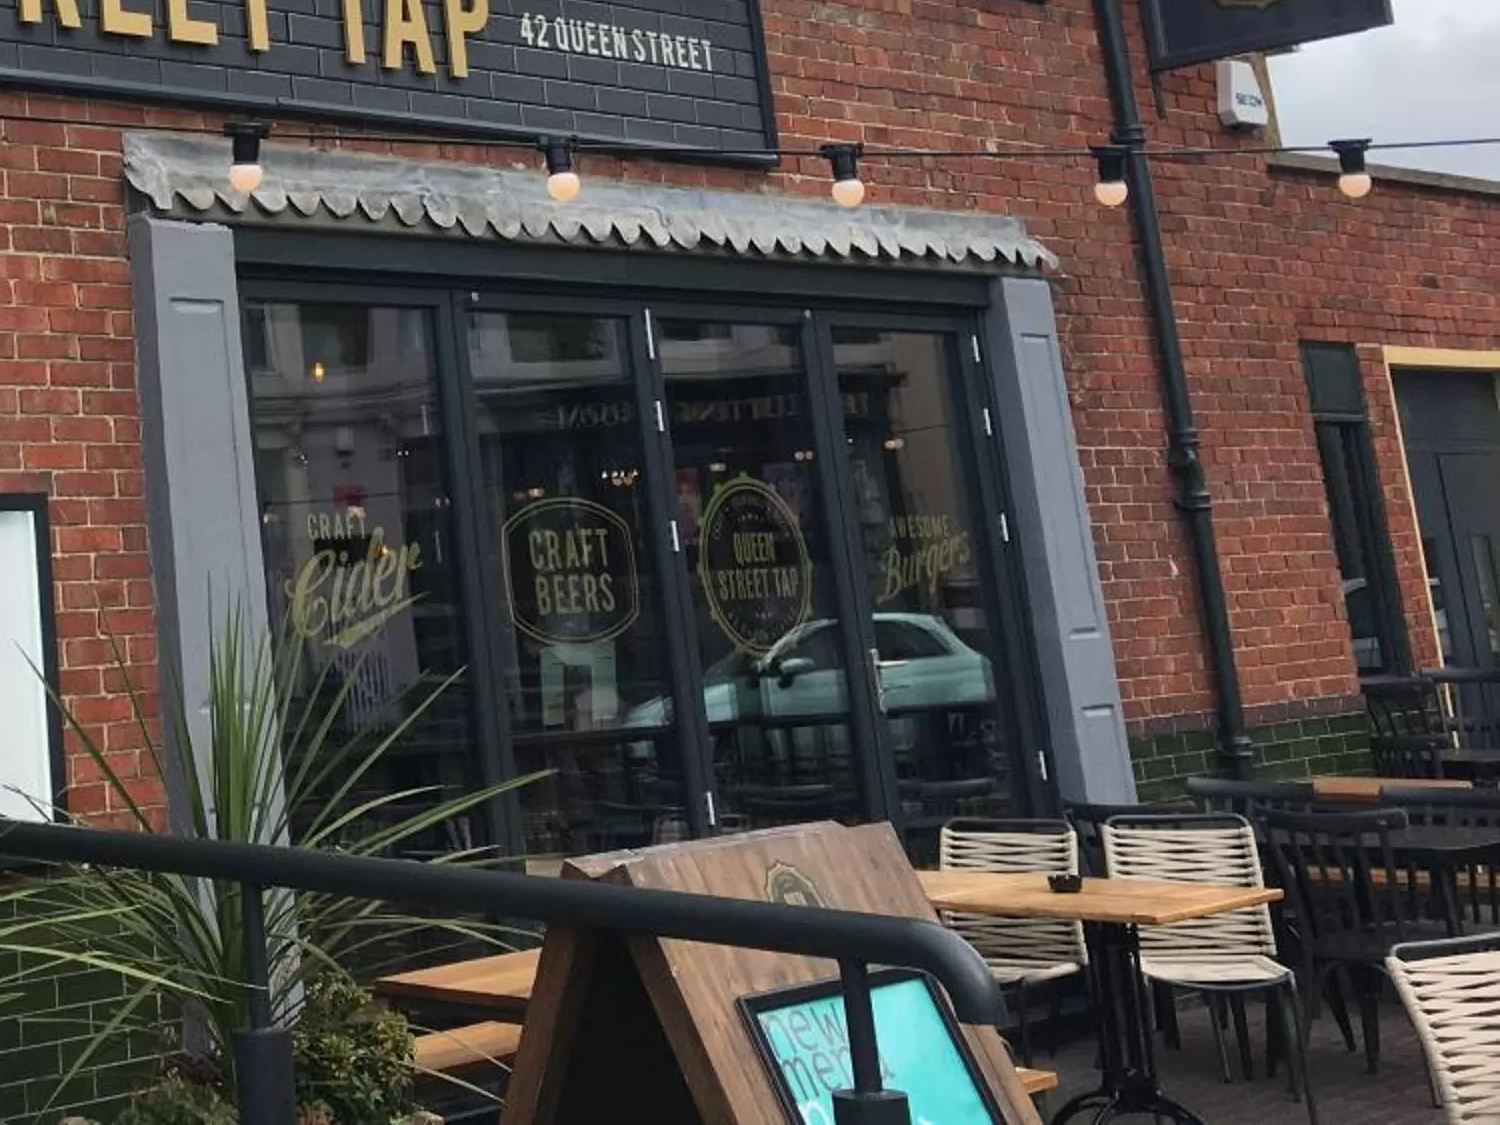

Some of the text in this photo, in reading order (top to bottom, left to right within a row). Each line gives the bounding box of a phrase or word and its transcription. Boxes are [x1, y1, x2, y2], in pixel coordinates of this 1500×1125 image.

[519, 12, 714, 72] 42 QUEEN STREET
[307, 512, 367, 540] CRAFT
[888, 513, 949, 539] AWESOME
[529, 528, 608, 572] CRAFT
[732, 530, 776, 567] QUEEN
[876, 531, 971, 605] Burgers
[284, 526, 424, 639] Cider
[535, 572, 616, 616] BEERS
[717, 567, 799, 601] STREET TAP
[765, 1001, 848, 1058] new
[782, 1047, 896, 1102] men
